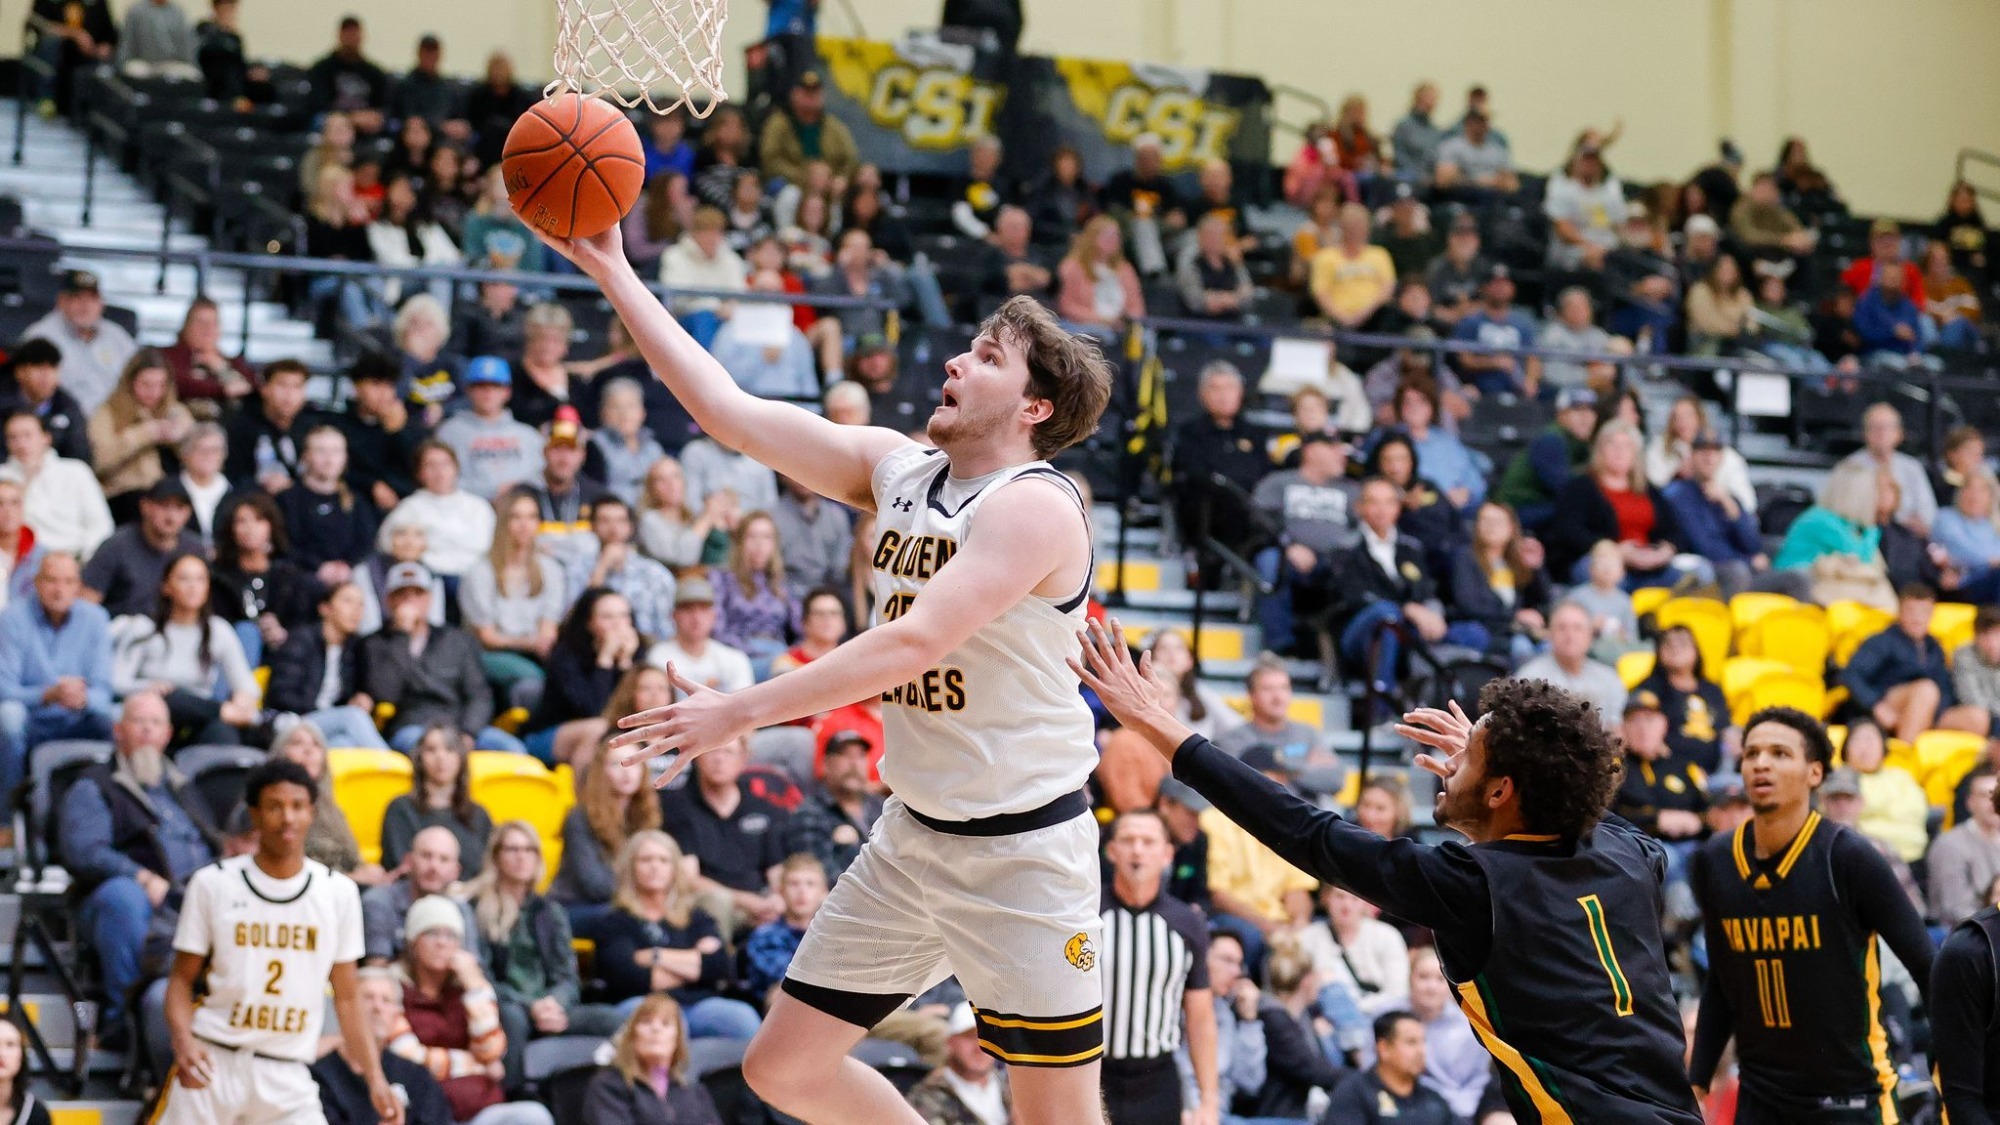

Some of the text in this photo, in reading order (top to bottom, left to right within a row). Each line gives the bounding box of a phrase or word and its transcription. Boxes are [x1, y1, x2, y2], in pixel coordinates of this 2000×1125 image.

[235, 922, 317, 951] GOLDEN
[1721, 914, 1821, 952] YAVAPAI
[1076, 951, 1095, 972] CSI
[1576, 894, 1634, 1017] 1
[264, 959, 284, 995] 2
[1755, 959, 1791, 1027] 11
[229, 1001, 307, 1031] EAGLES
